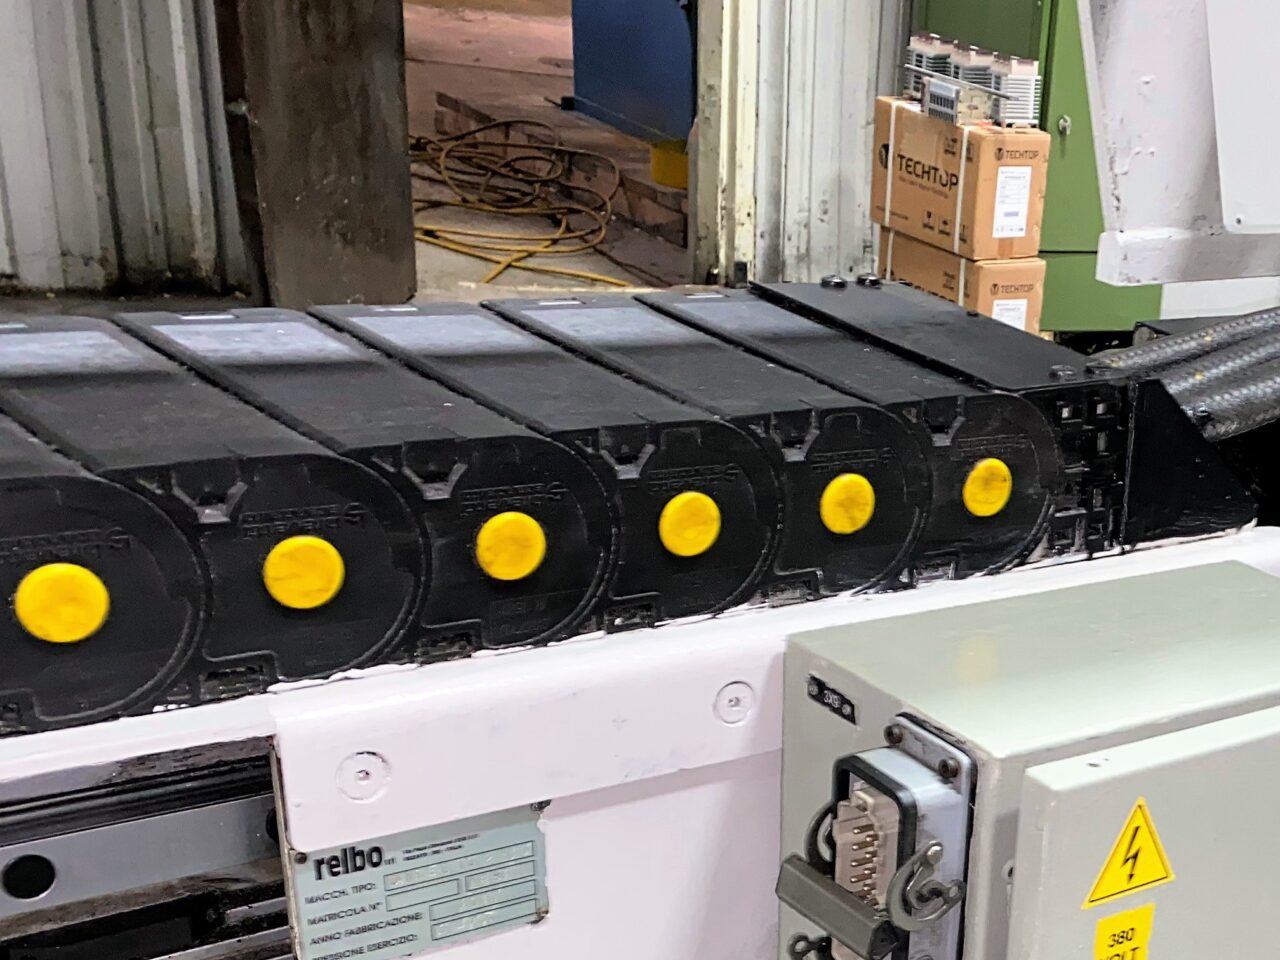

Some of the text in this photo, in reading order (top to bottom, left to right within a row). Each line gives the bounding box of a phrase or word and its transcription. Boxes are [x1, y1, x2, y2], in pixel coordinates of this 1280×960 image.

[1005, 150, 1039, 160] TECHTOP
[897, 153, 959, 191] TECHTOP
[1001, 284, 1035, 294] TECHTOP
[313, 846, 383, 881] relbo
[309, 932, 342, 945] ANNO
[1108, 927, 1136, 948] 380
